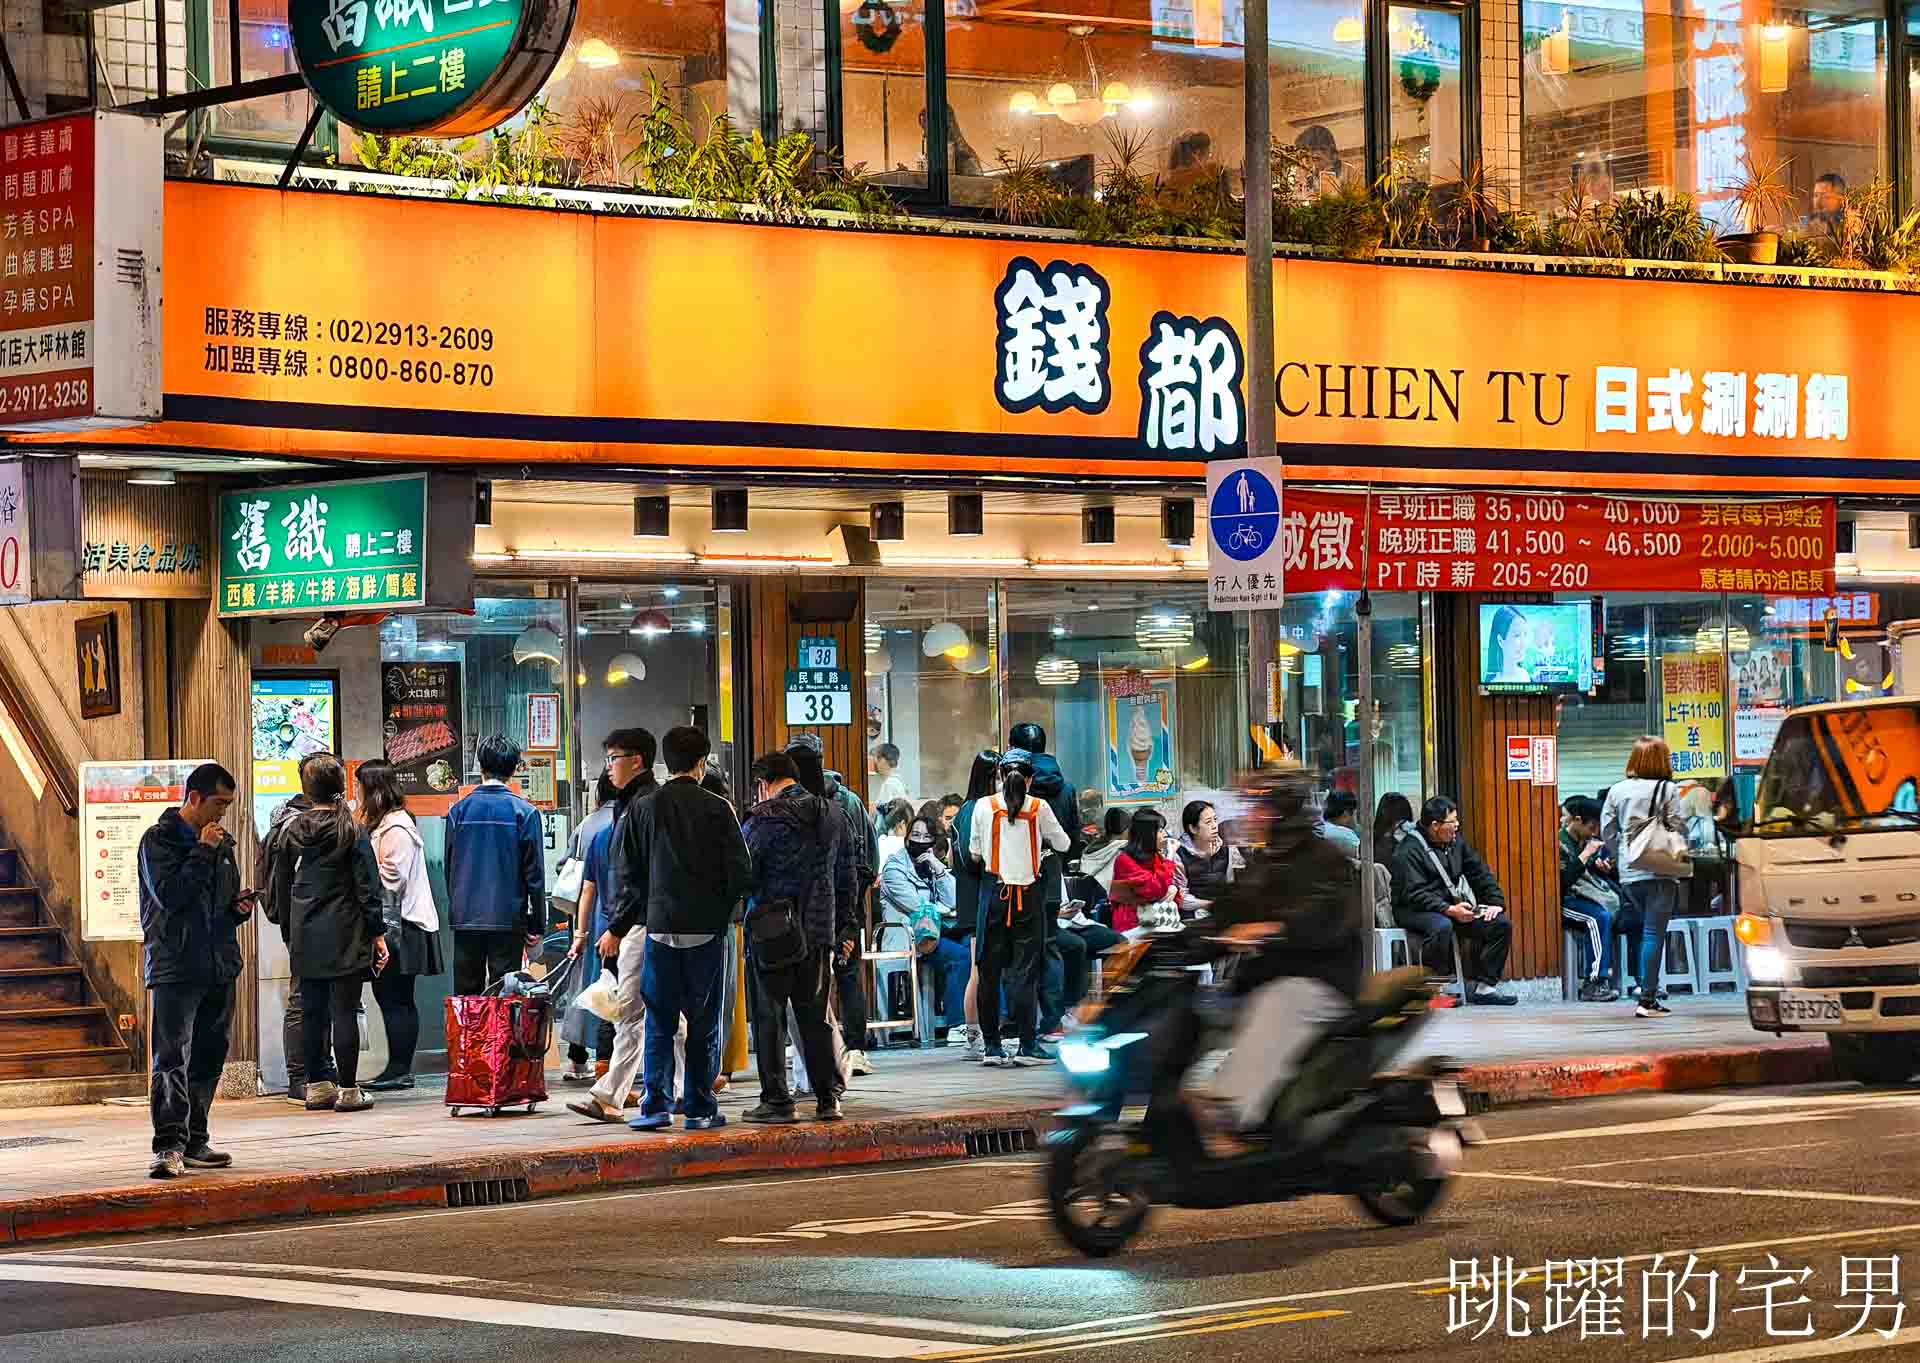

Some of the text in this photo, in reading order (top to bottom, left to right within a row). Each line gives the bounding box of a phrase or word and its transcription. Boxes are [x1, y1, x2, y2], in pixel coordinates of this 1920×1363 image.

[356, 47, 466, 111] 請上二樓
[4, 126, 73, 162] 醫美護膚
[4, 166, 73, 201] 問題肌膚
[3, 207, 75, 240] 芳香SPA
[4, 243, 73, 278] 曲線雕塑
[3, 284, 75, 316] 孕婦SPA
[1003, 268, 1239, 453] 錢都
[1275, 361, 1571, 426] CHIEN TU
[1595, 366, 1849, 440] 日式涮涮鍋
[1378, 495, 1476, 521] 早班正職
[1485, 496, 1565, 523] 35,000
[1603, 501, 1680, 526] 40,000
[345, 528, 413, 559] 請上二樓
[1378, 527, 1477, 554] 晚班正職
[1485, 529, 1565, 555] 41,500
[1604, 532, 1681, 557] 46,500
[1214, 572, 1277, 592] 行人優先
[1492, 562, 1589, 588] 205~260
[1700, 568, 1824, 593] 意者請內洽店長
[815, 649, 831, 666] 38
[1663, 663, 1720, 695] 營業時間
[805, 694, 834, 722] 38
[1664, 701, 1722, 724] 上午11:00
[1687, 726, 1701, 748] 至
